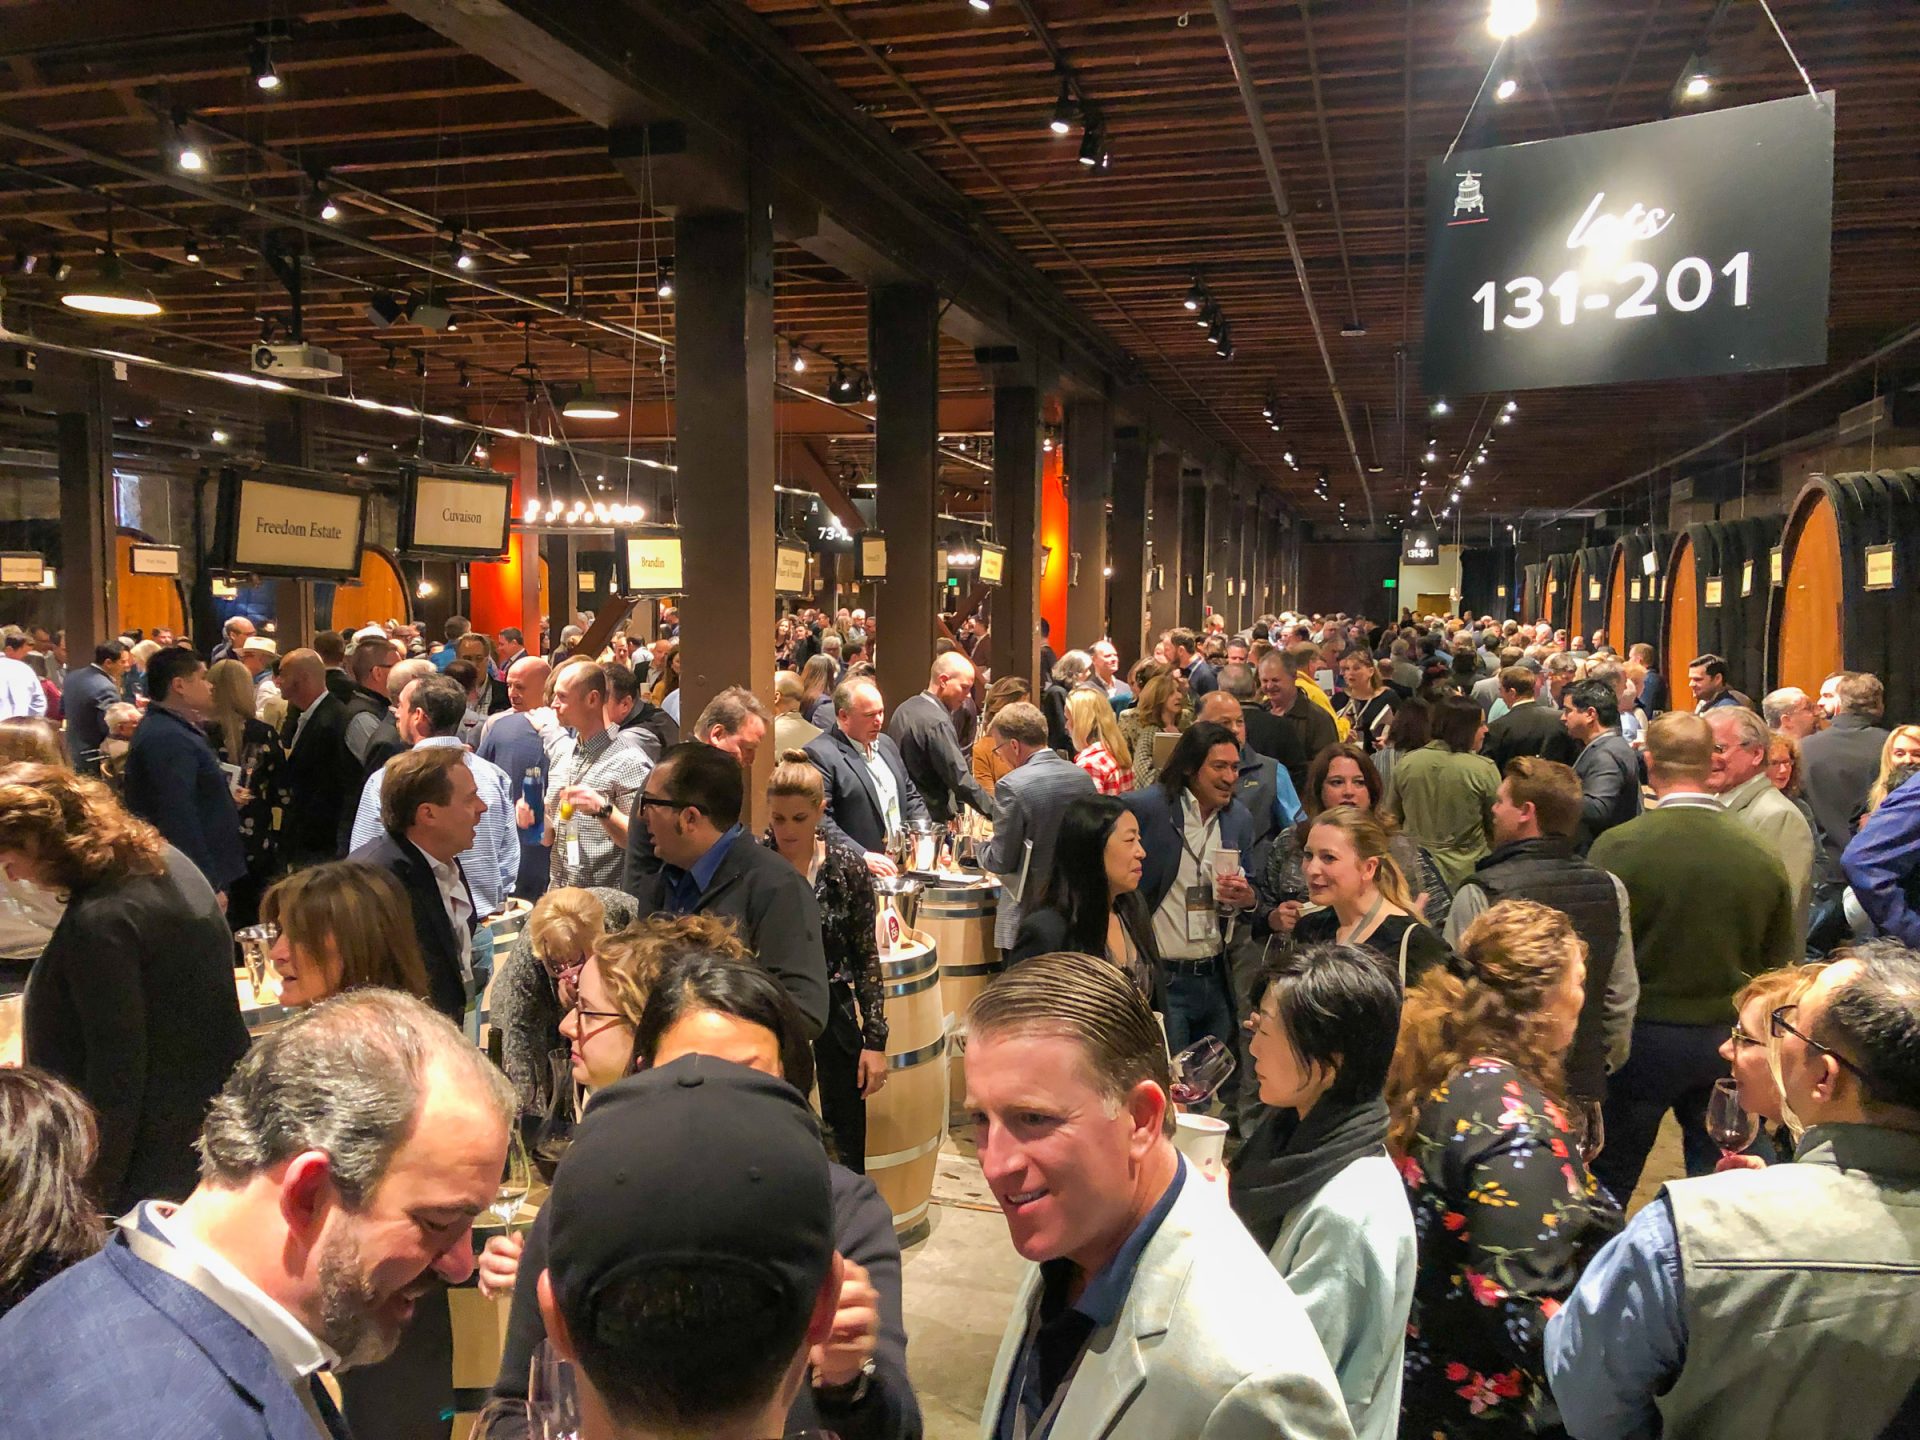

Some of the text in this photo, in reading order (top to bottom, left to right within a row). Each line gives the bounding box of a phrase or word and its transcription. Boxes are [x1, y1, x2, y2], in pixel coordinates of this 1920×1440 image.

[1472, 251, 1750, 332] 131-201
[442, 507, 482, 524] Cuvaison
[255, 516, 343, 540] Freedom Estate
[641, 556, 665, 568] Brandlin
